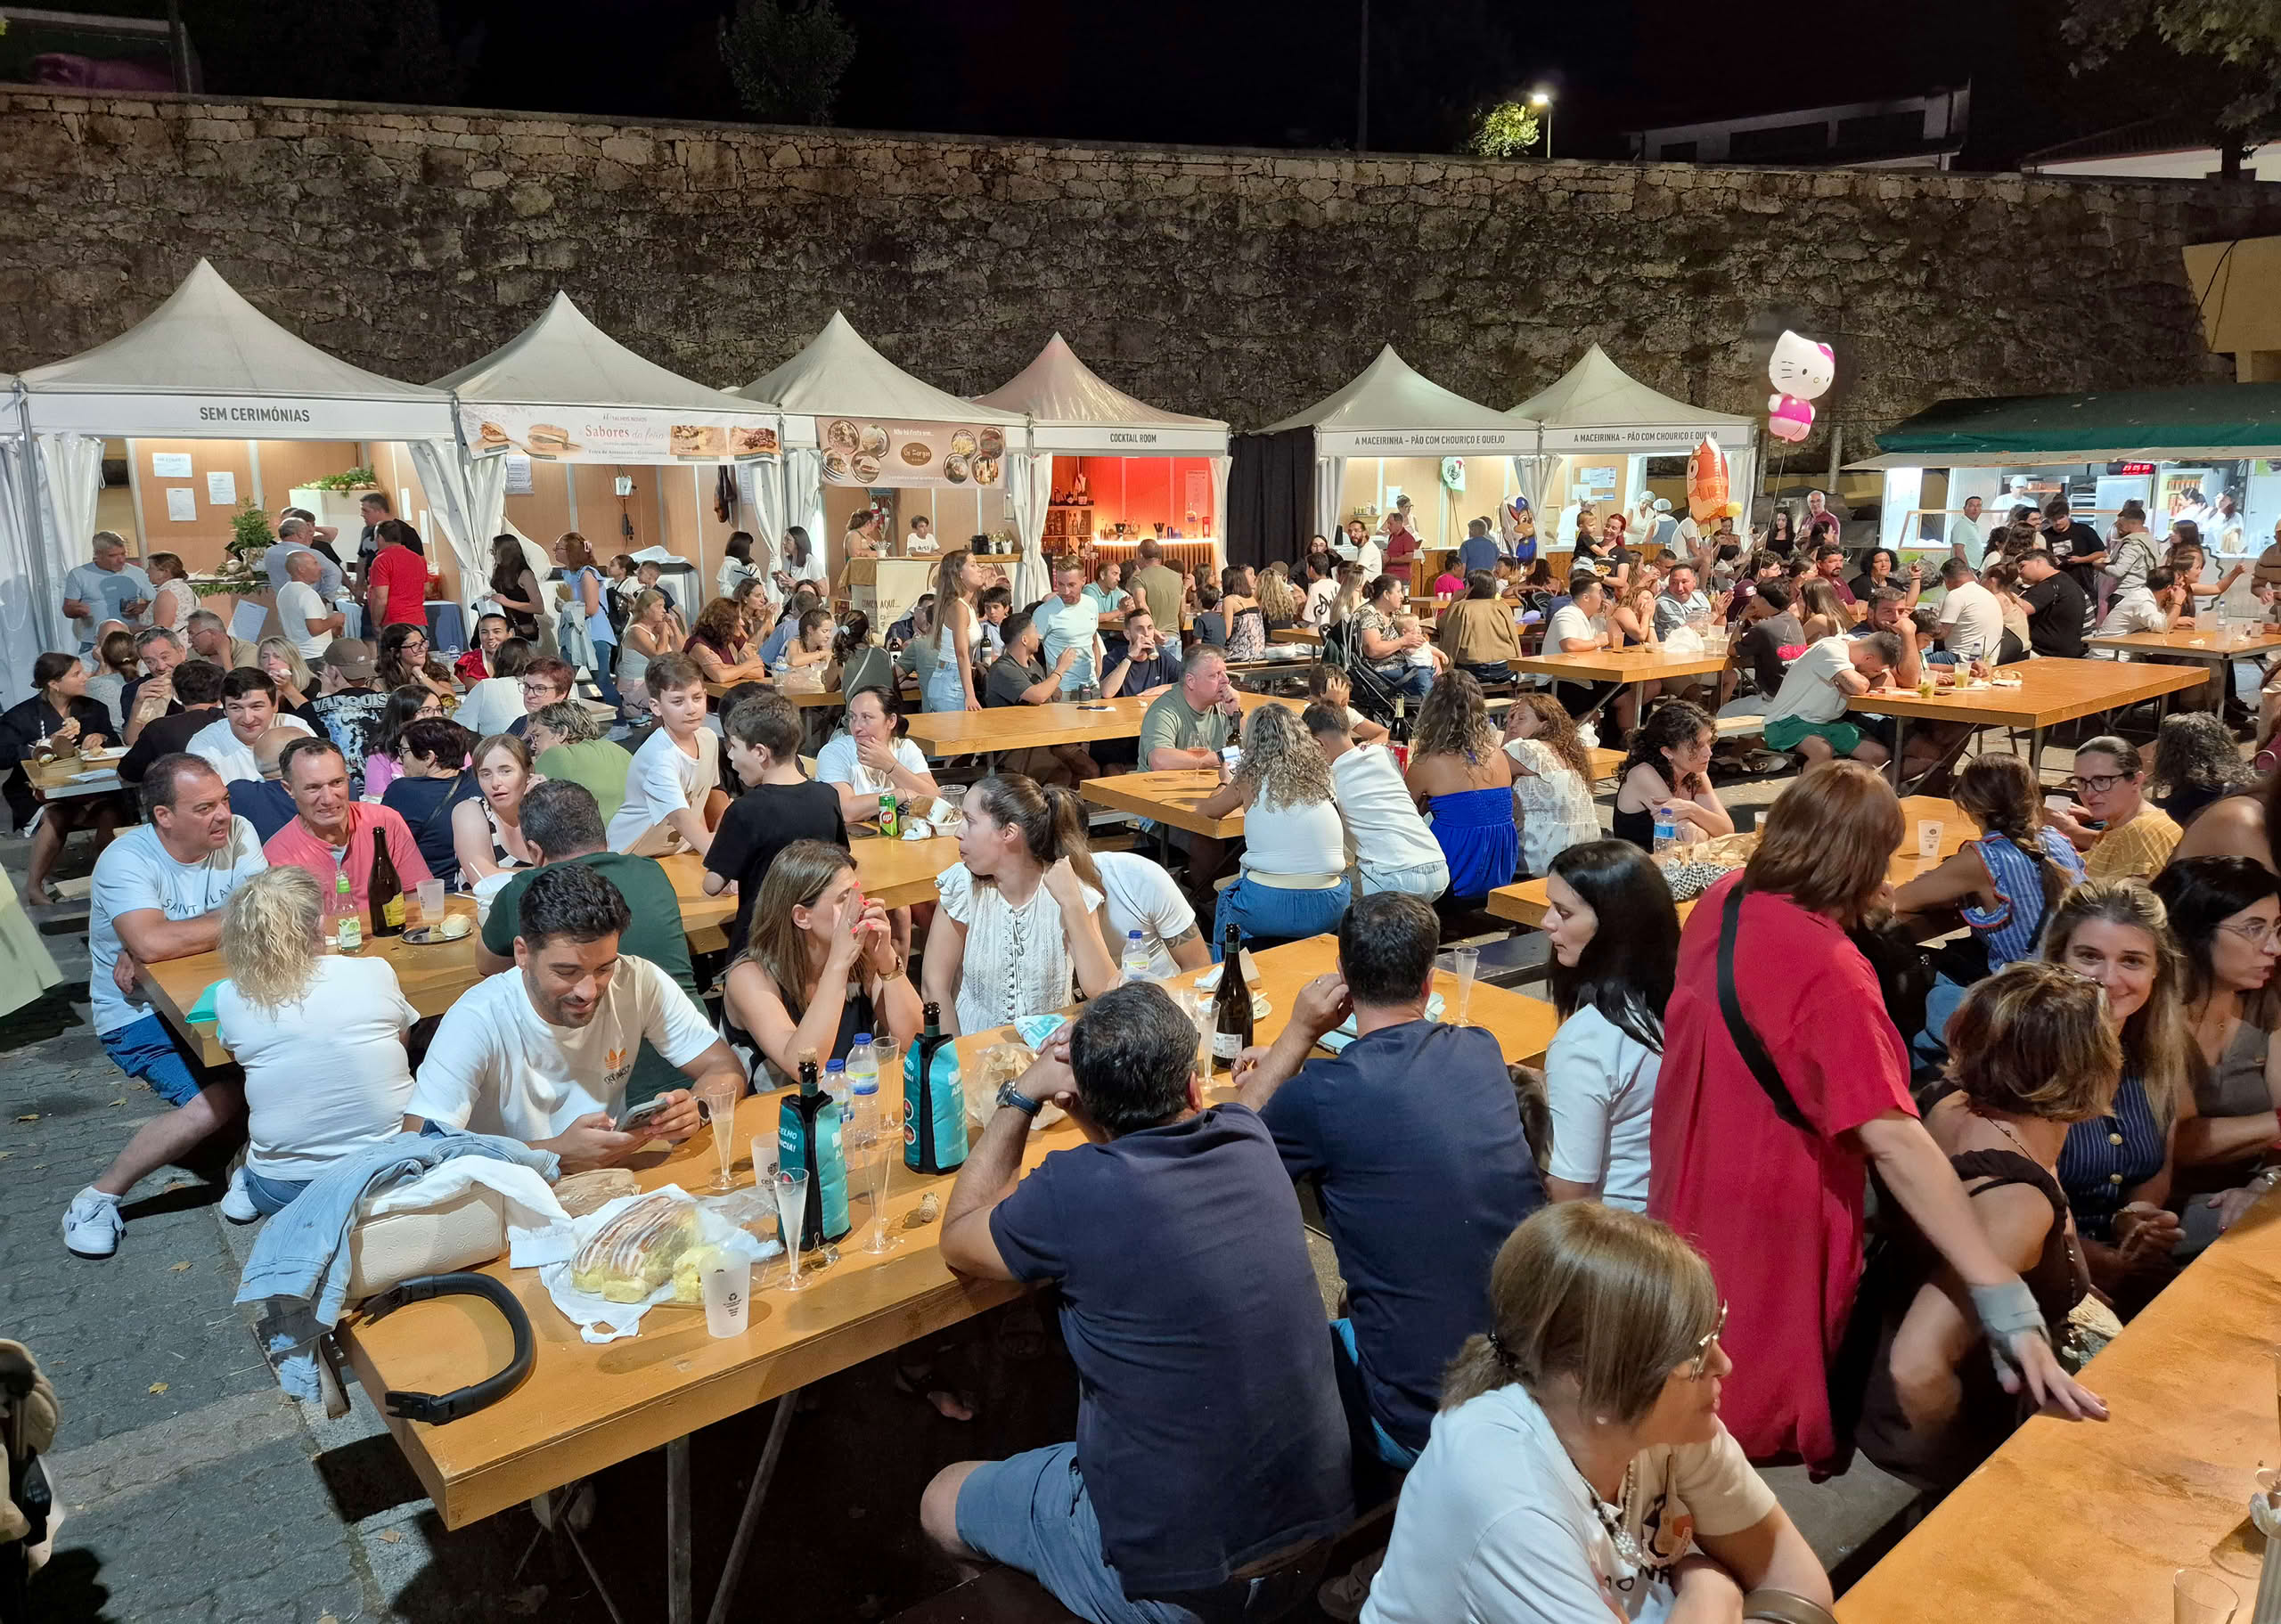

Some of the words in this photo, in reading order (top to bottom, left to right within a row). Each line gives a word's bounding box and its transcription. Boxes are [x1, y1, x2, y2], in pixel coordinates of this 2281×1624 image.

[200, 407, 227, 420] SEM
[231, 406, 310, 422] CERIMÓNIAS
[585, 424, 630, 437] Sabores
[1574, 434, 1579, 443] A
[1580, 433, 1620, 443] MACEIRINHA
[1627, 431, 1639, 441] PÃO
[1641, 432, 1655, 441] COM
[1656, 431, 1688, 442] CHOURIÇO
[1690, 431, 1694, 440] E
[1110, 433, 1138, 443] COCKTAIL
[1139, 434, 1157, 443] ROOM
[1354, 437, 1360, 445] A
[1361, 437, 1403, 445] MACEIRINHA
[1410, 435, 1424, 445] PÃO
[1426, 436, 1440, 445] COM
[1441, 435, 1475, 446] CHOURIÇO
[1476, 435, 1480, 444] E
[1482, 435, 1505, 445] QUEIJO
[312, 693, 390, 712] VANQUIS
[162, 898, 197, 915] SAINT
